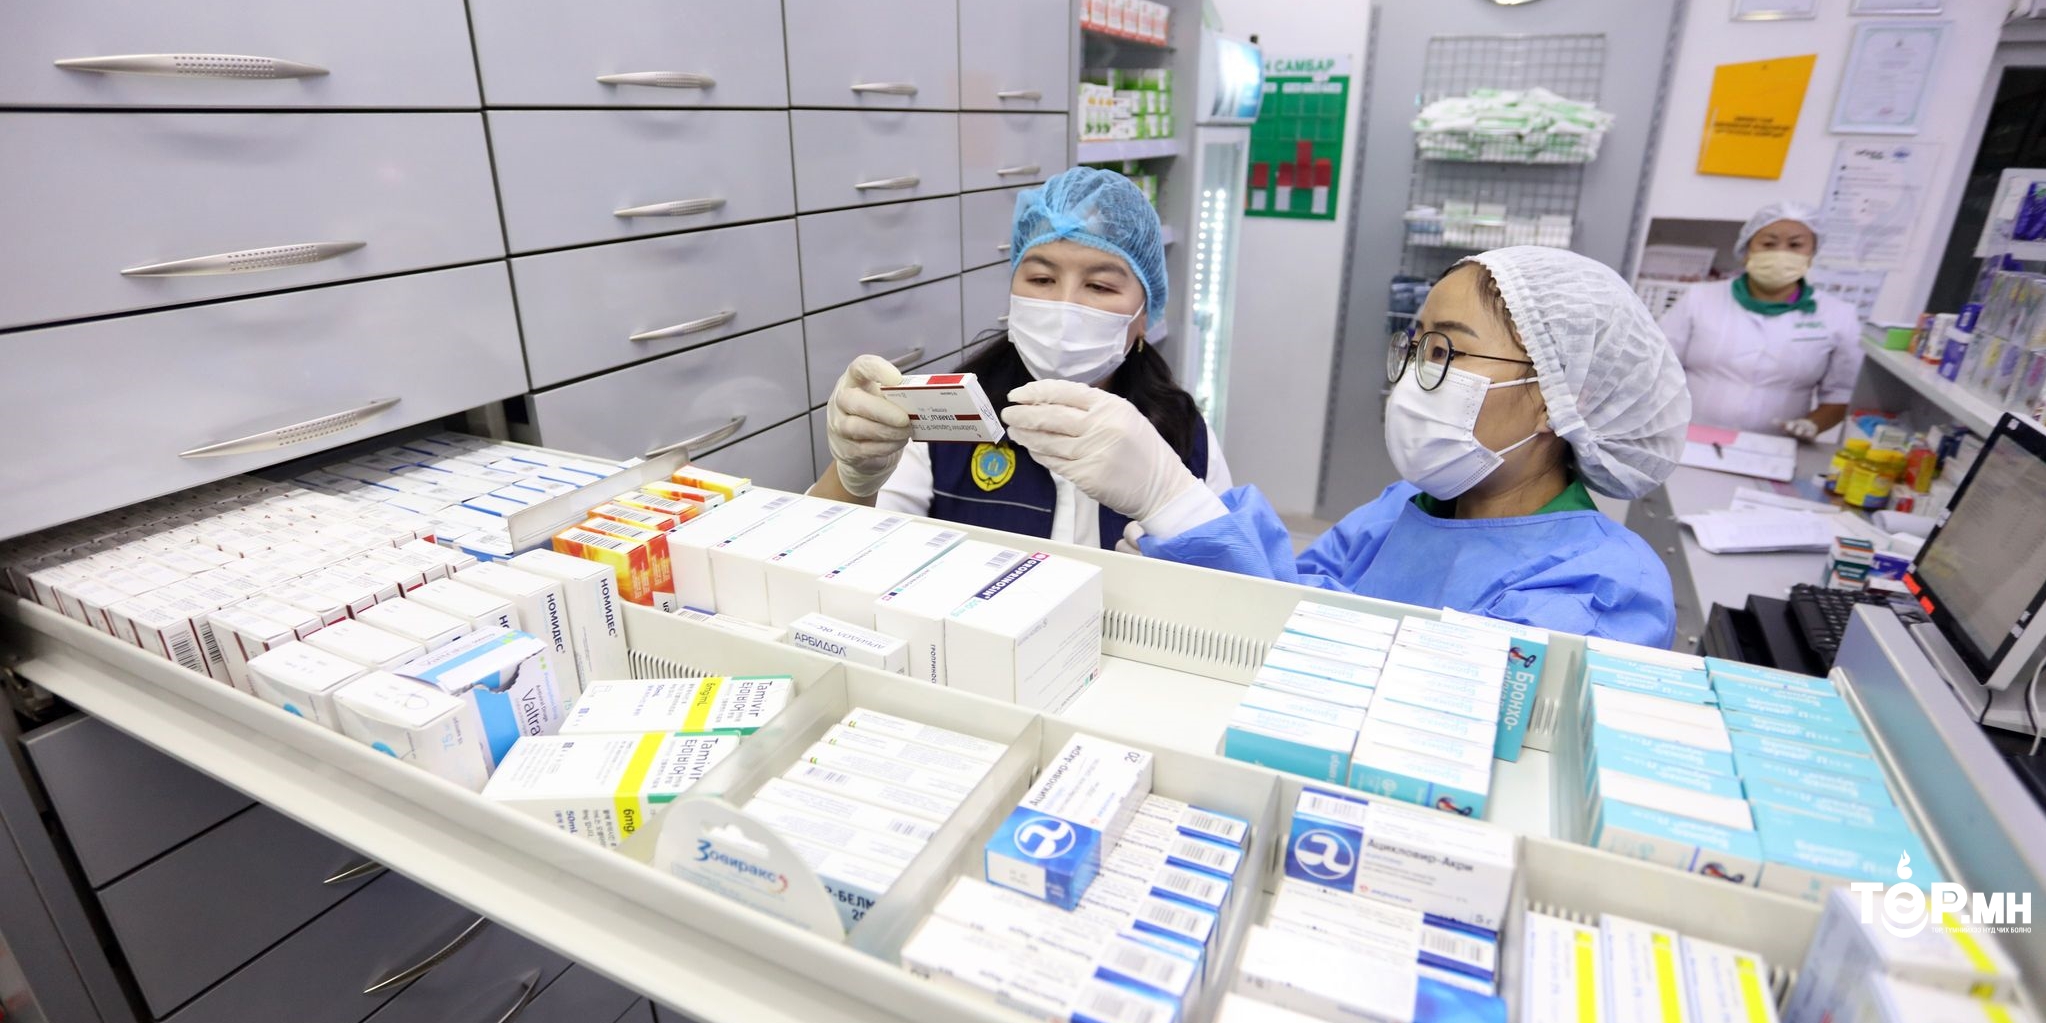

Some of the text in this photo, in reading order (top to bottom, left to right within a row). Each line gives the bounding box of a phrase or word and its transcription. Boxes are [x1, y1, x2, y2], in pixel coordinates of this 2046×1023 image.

[1275, 57, 1334, 72] САМБАР
[983, 559, 1038, 600] GROPRINOSIN
[546, 592, 564, 653] НОМИДЕС
[600, 577, 617, 639] НОМИДЕС
[794, 631, 847, 657] АРБИДОЛ
[521, 688, 543, 737] Valtra
[732, 681, 753, 712] 타미비어
[748, 680, 773, 718] Tamivir
[672, 739, 697, 774] 타미비어
[688, 737, 719, 781] Tamivir
[1029, 744, 1083, 807] Ацикловир-Акри
[1124, 750, 1141, 764] 20
[622, 808, 635, 834] 6mg
[693, 838, 778, 883] Зовиракс
[1366, 837, 1474, 873] Ацикловир-Акри
